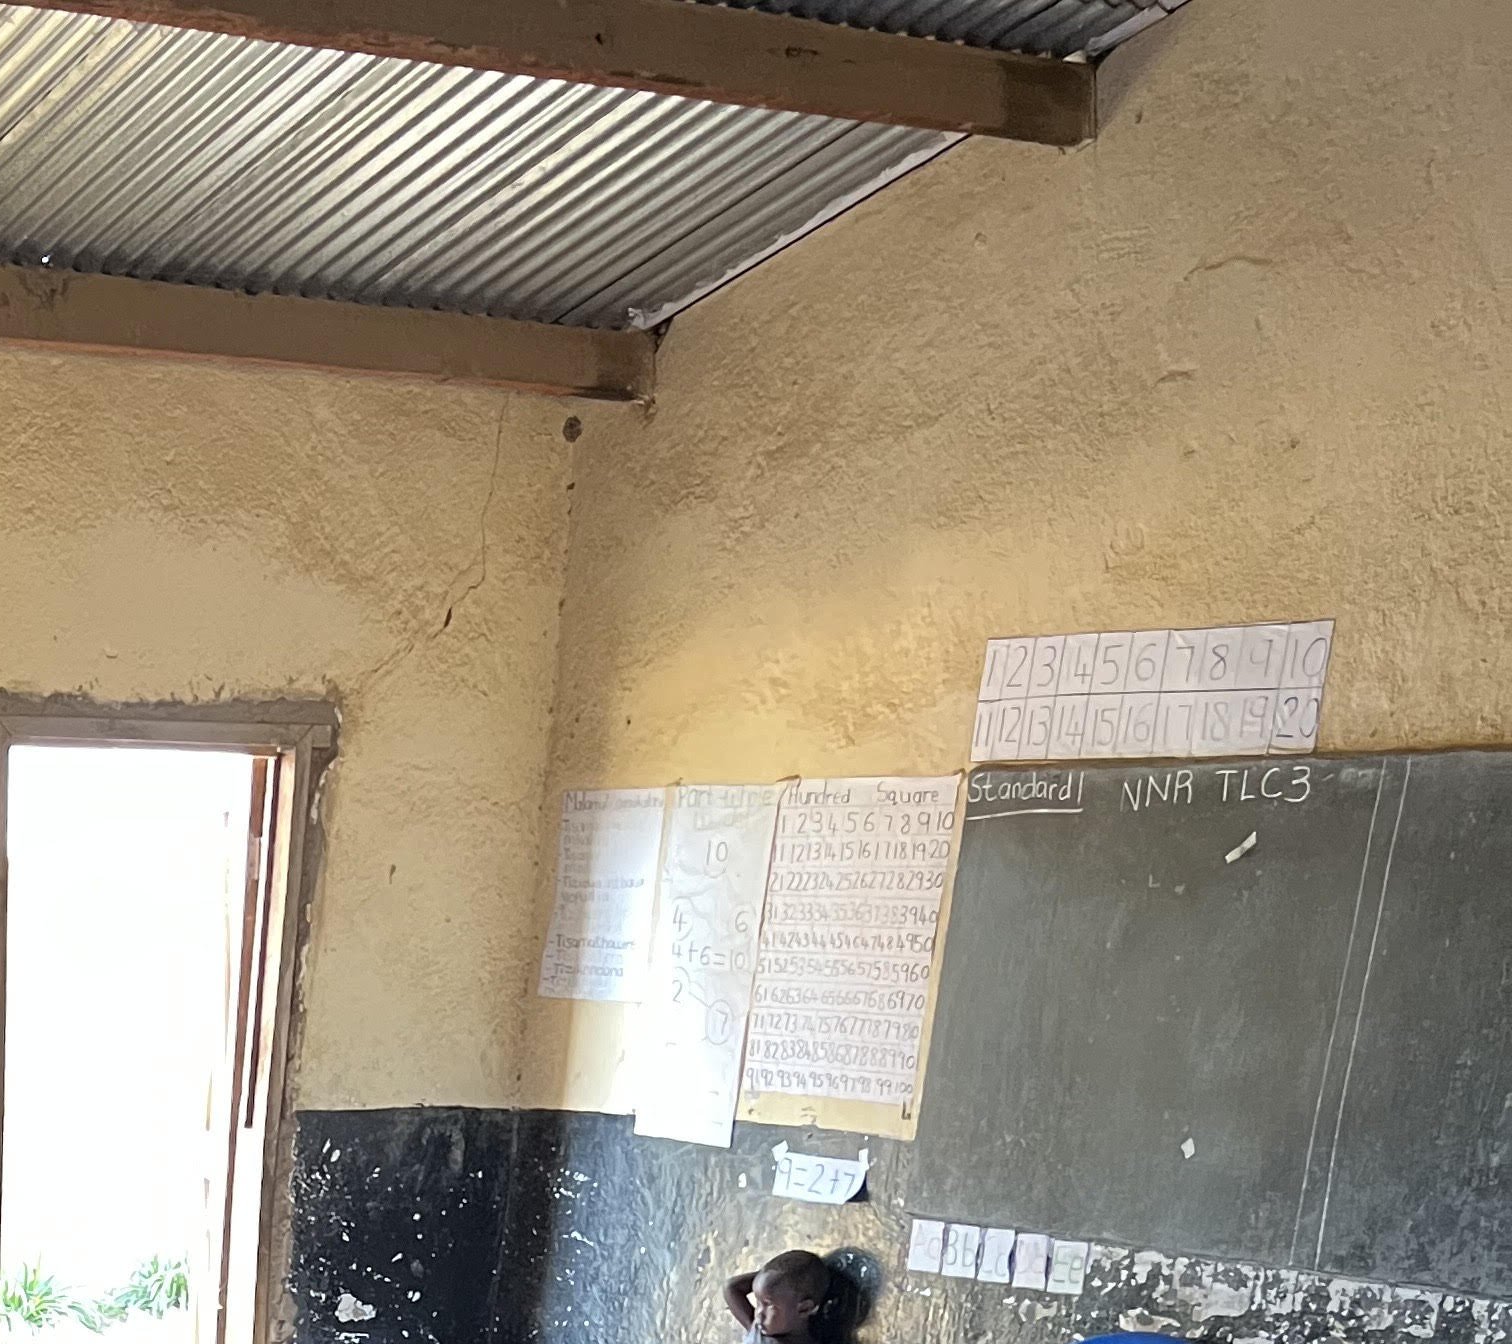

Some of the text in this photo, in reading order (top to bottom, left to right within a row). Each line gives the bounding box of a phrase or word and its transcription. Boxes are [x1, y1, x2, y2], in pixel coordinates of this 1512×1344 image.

[1006, 646, 1028, 688] 2
[1037, 646, 1057, 687] 3
[1074, 646, 1092, 684] 4
[1100, 644, 1123, 685] 5
[1135, 643, 1157, 681] 6
[1176, 646, 1195, 683] 7
[1209, 644, 1229, 680] 8
[1290, 637, 1328, 679] 10
[975, 696, 1320, 747] 11 12 13 14 15 16 17 18 19 20
[788, 780, 940, 806] Hundred Square
[797, 813, 807, 834] 2
[812, 812, 823, 833] 3
[828, 813, 839, 836] 4
[845, 811, 859, 834] 5
[863, 812, 875, 832] 6
[884, 814, 893, 832] 7
[900, 813, 911, 835] 8
[917, 811, 931, 832] 9
[936, 811, 955, 831] 10
[706, 840, 728, 866] 10
[735, 910, 749, 933] 6
